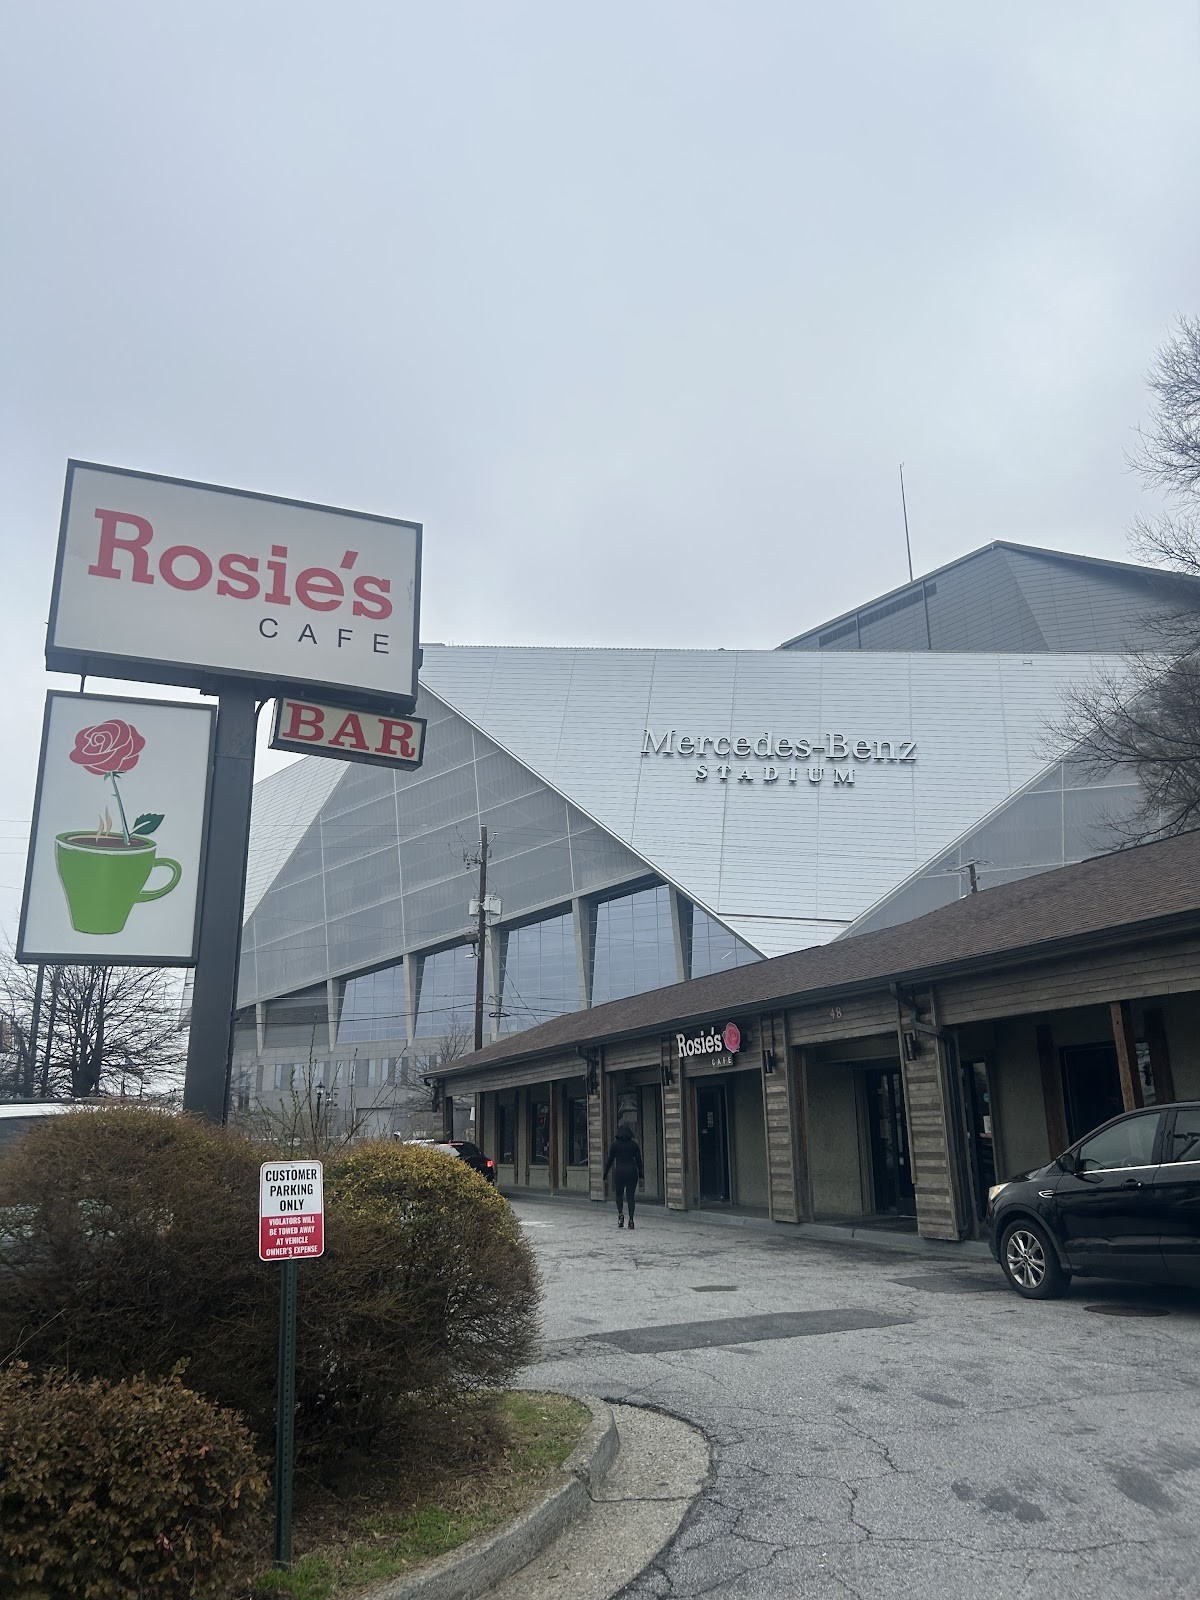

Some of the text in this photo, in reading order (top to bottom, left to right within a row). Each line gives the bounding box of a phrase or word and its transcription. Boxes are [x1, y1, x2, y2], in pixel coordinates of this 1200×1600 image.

[87, 508, 393, 620] Rosie's
[258, 617, 390, 655] CAFE
[282, 702, 416, 758] BAR
[641, 729, 918, 761] Mercedes-Benz
[695, 764, 856, 785] STADIUM
[829, 1007, 842, 1019] 48
[676, 1027, 723, 1058] Rosie's
[711, 1056, 732, 1067] CAFE
[265, 1169, 317, 1181] CUSTOMER
[270, 1184, 313, 1197] PARKING
[280, 1199, 304, 1211] ONLY
[269, 1216, 315, 1226] VIOLATORS WILL
[269, 1225, 316, 1236] BE TOWED AWAY
[276, 1236, 309, 1246] AT VEHICLE
[266, 1245, 317, 1256] OWNER'S EXPENSE
